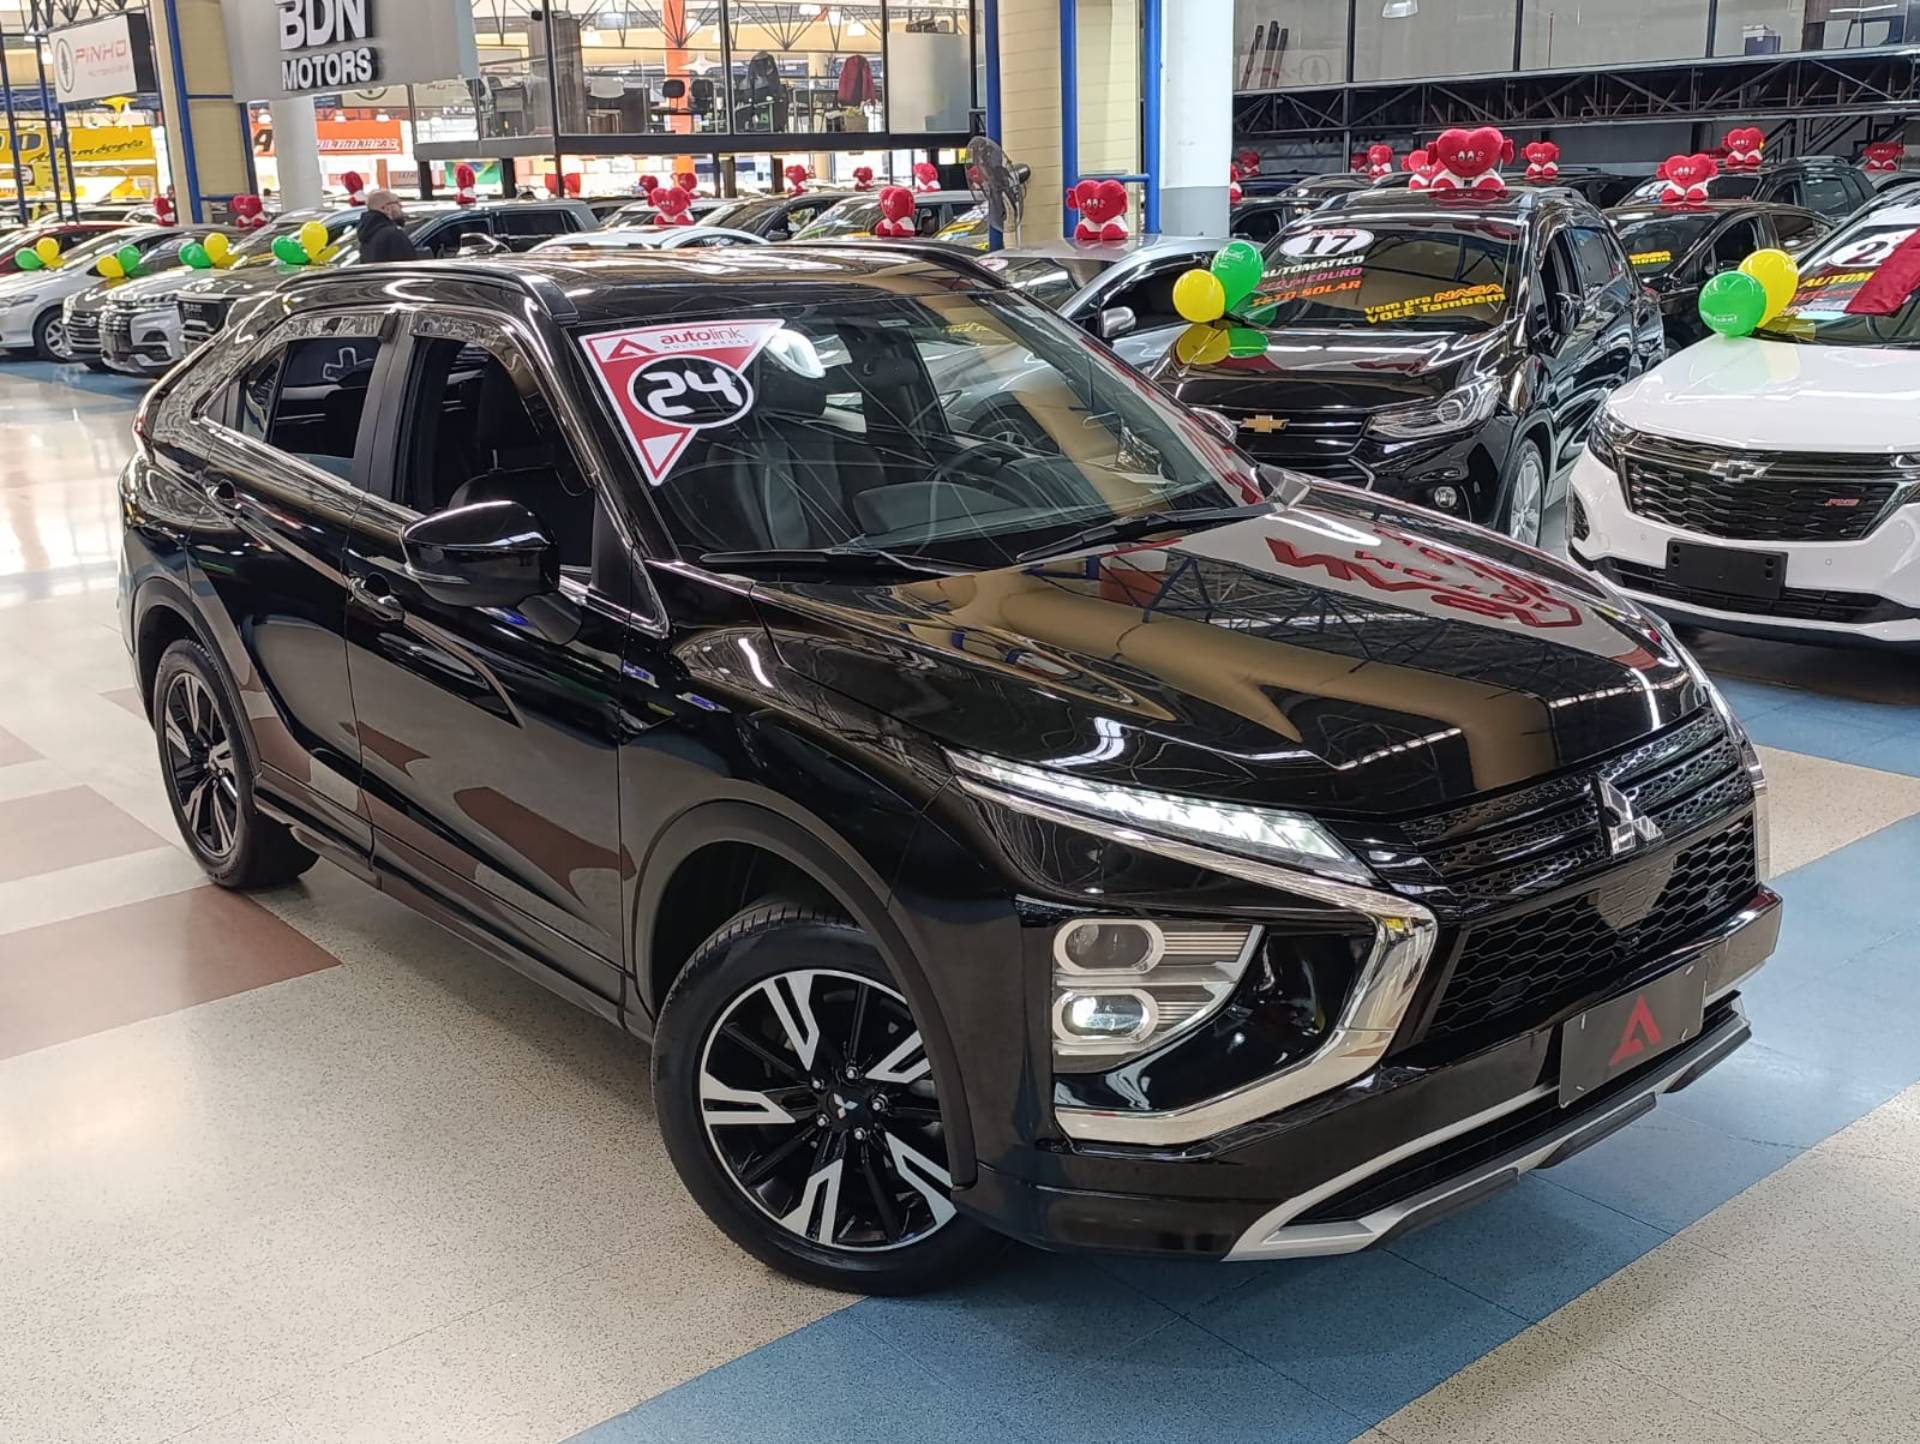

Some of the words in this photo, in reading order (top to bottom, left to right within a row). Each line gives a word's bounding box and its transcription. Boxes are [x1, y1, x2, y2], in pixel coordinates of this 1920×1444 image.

[277, 0, 367, 50] BDN
[75, 40, 127, 64] PINHO
[281, 47, 373, 91] MOTORS
[1298, 235, 1357, 255] 17
[1302, 279, 1362, 297] SOLAR
[1364, 300, 1400, 315] Vem
[1404, 296, 1431, 310] pra
[1434, 283, 1503, 302] NASA
[661, 327, 745, 344] autolink
[642, 367, 743, 416] 24
